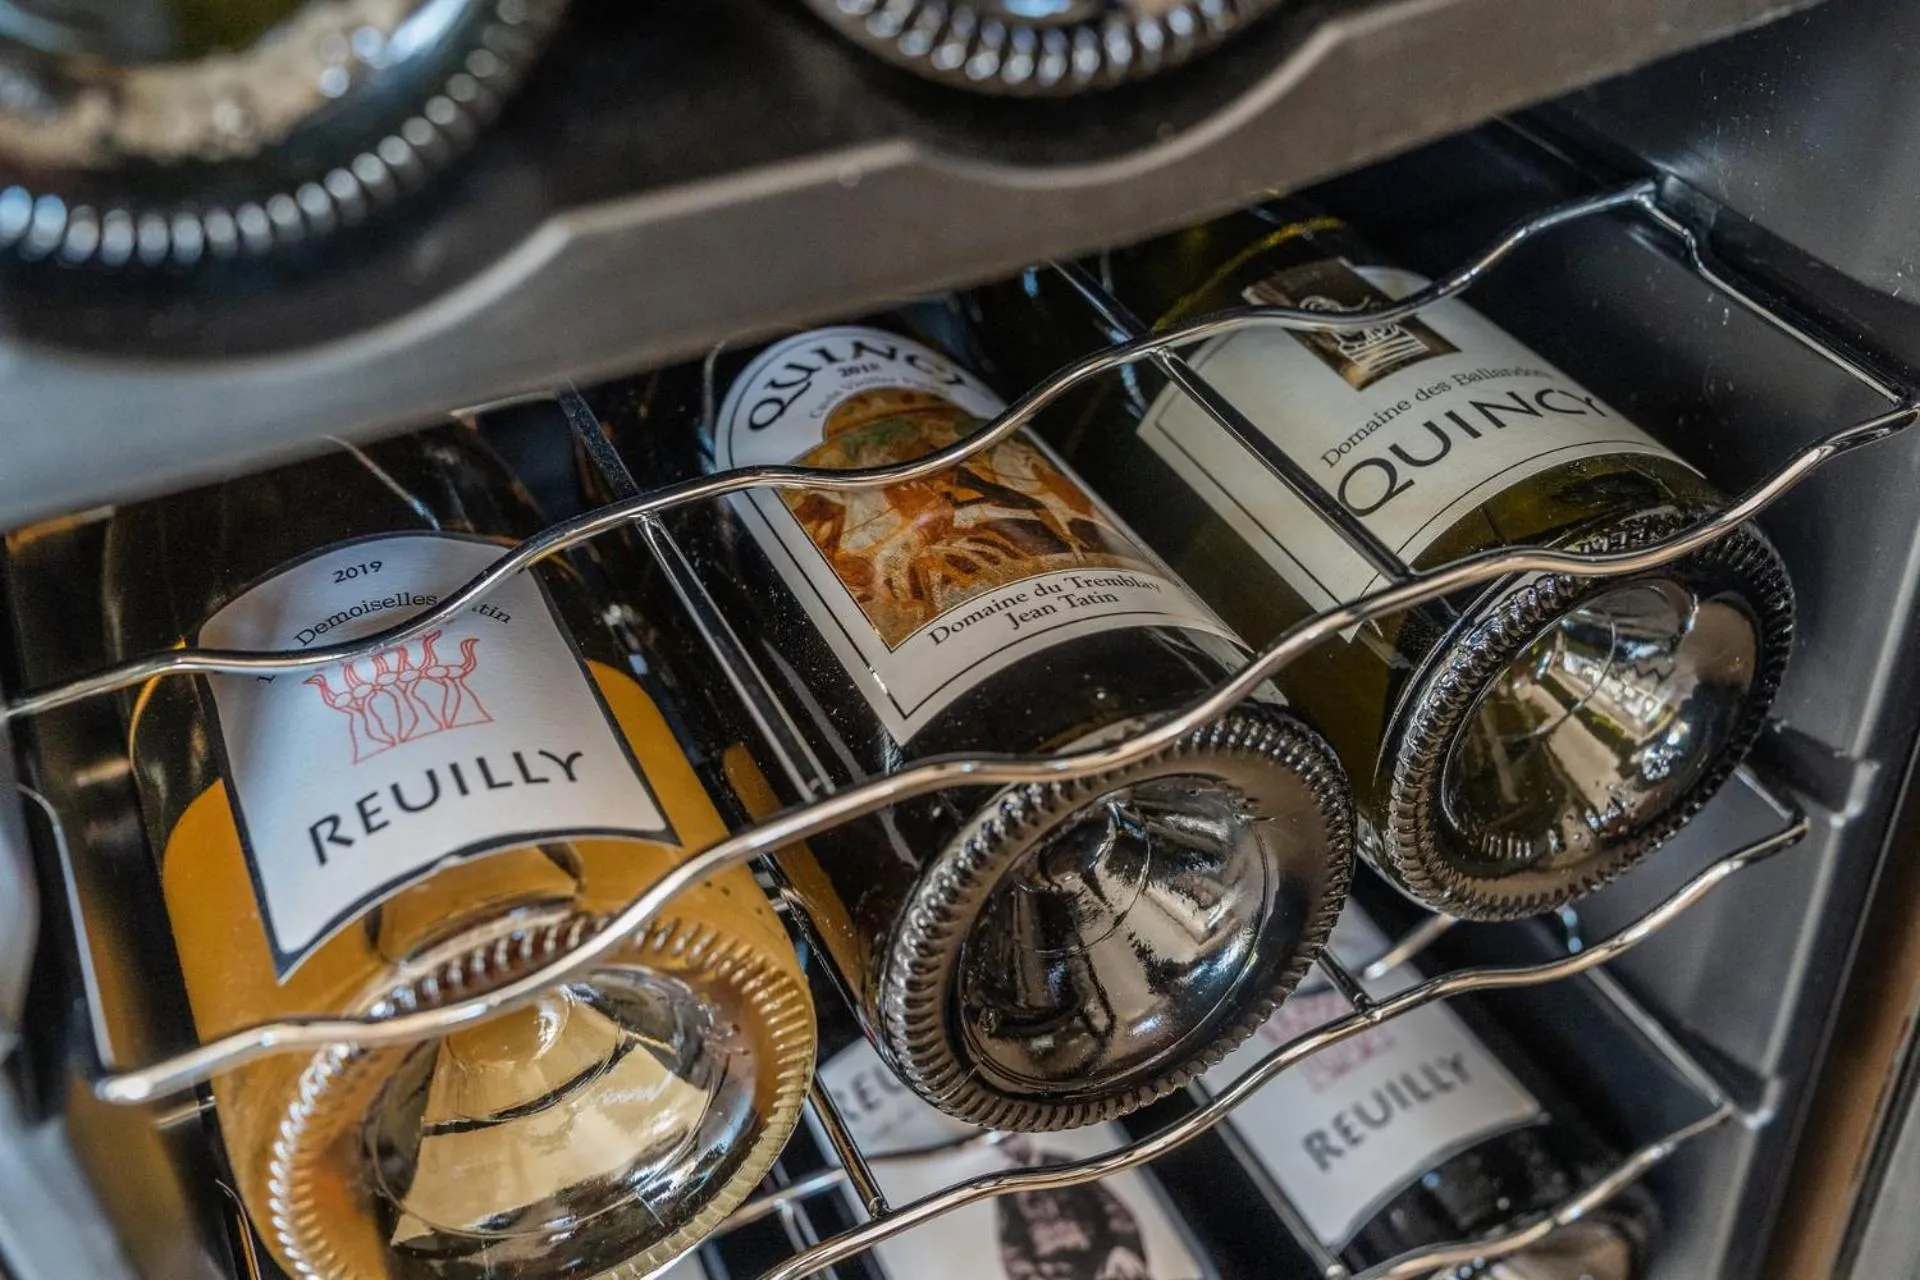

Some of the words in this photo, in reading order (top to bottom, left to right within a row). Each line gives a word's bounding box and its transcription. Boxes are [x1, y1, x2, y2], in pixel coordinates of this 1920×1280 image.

[749, 341, 966, 431] QUINCY
[1320, 399, 1412, 468] Domaine
[1415, 380, 1452, 402] des
[1337, 388, 1608, 517] QUINCY
[332, 560, 383, 584] 2019
[927, 592, 1029, 645] Domaine
[1034, 582, 1064, 598] du
[1064, 574, 1161, 593] Tremblay
[1004, 604, 1057, 630] Jean
[1057, 591, 1120, 610] Tatin
[294, 592, 438, 647] Demoiselles
[308, 750, 584, 865] REUILLY
[1302, 1052, 1472, 1174] REUILLY
